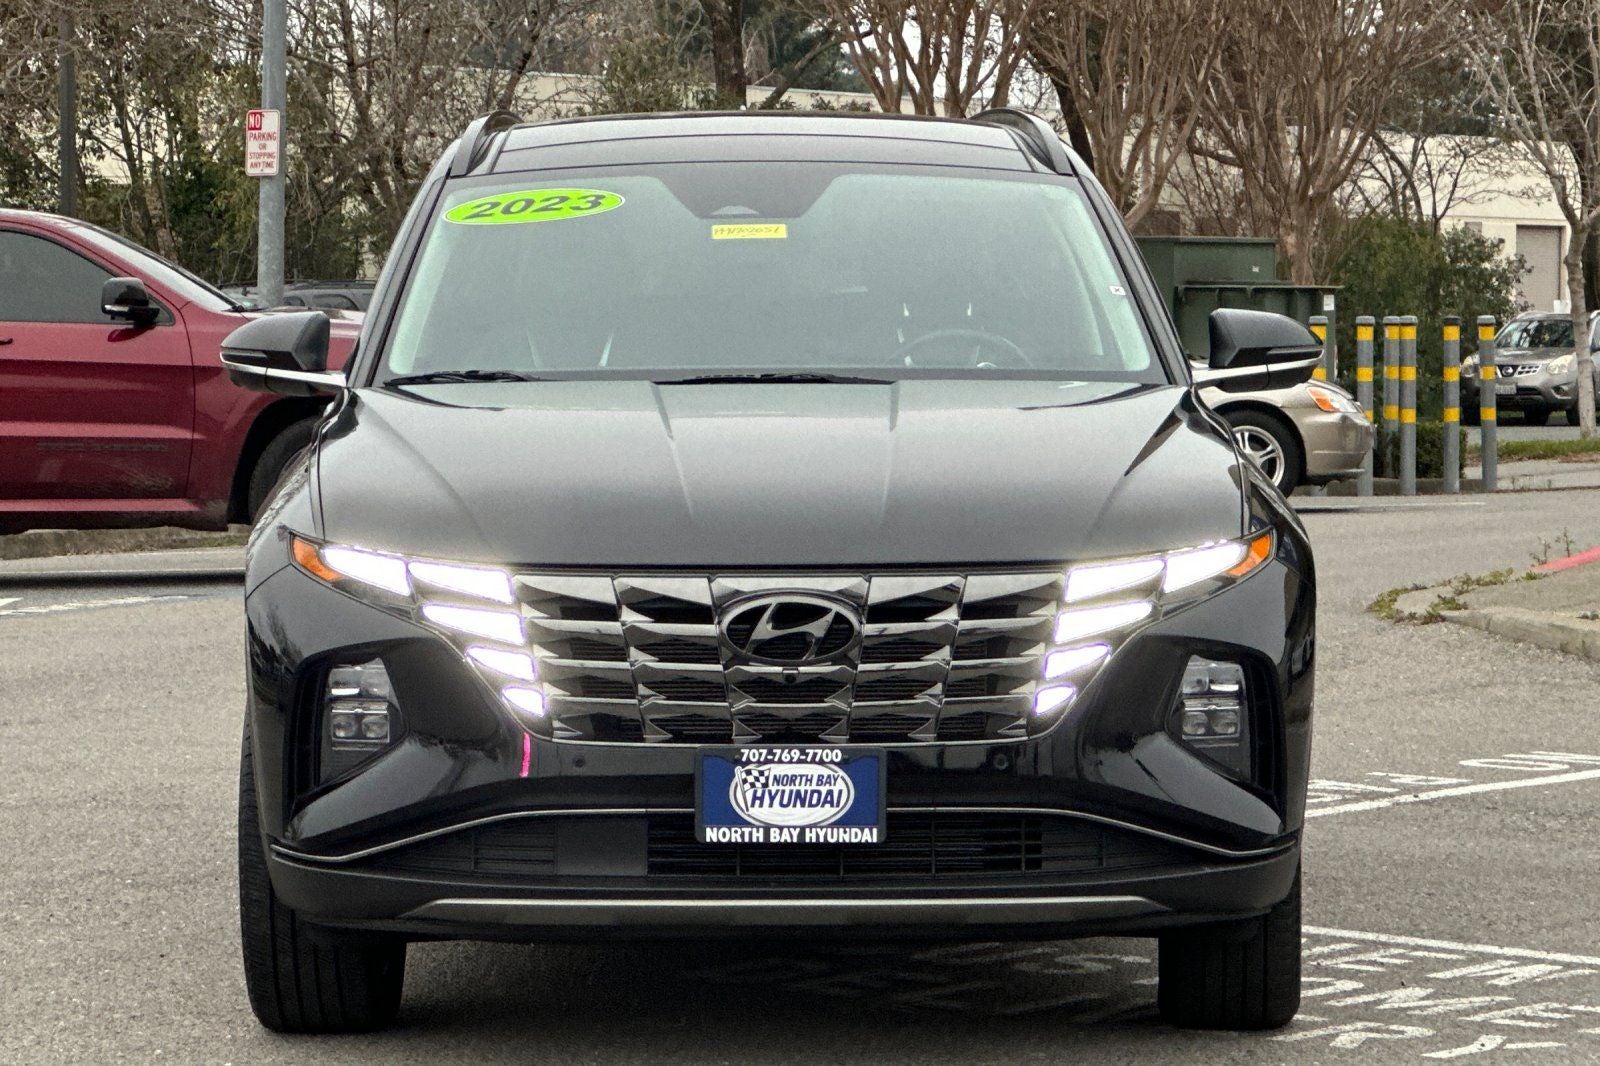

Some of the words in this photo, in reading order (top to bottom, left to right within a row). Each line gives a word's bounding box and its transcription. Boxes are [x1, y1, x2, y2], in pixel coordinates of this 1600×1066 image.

[248, 114, 261, 128] NO
[249, 132, 276, 140] PARKING
[258, 142, 266, 150] OR
[463, 194, 606, 220] 2023
[740, 748, 842, 762] 707-769-7700
[771, 774, 813, 787] NORTH
[815, 773, 840, 787] BAY
[750, 788, 843, 808] HYUNDAI
[705, 827, 764, 843] NORTH
[769, 827, 801, 843] BAY
[805, 827, 878, 843] HYUNDAI
